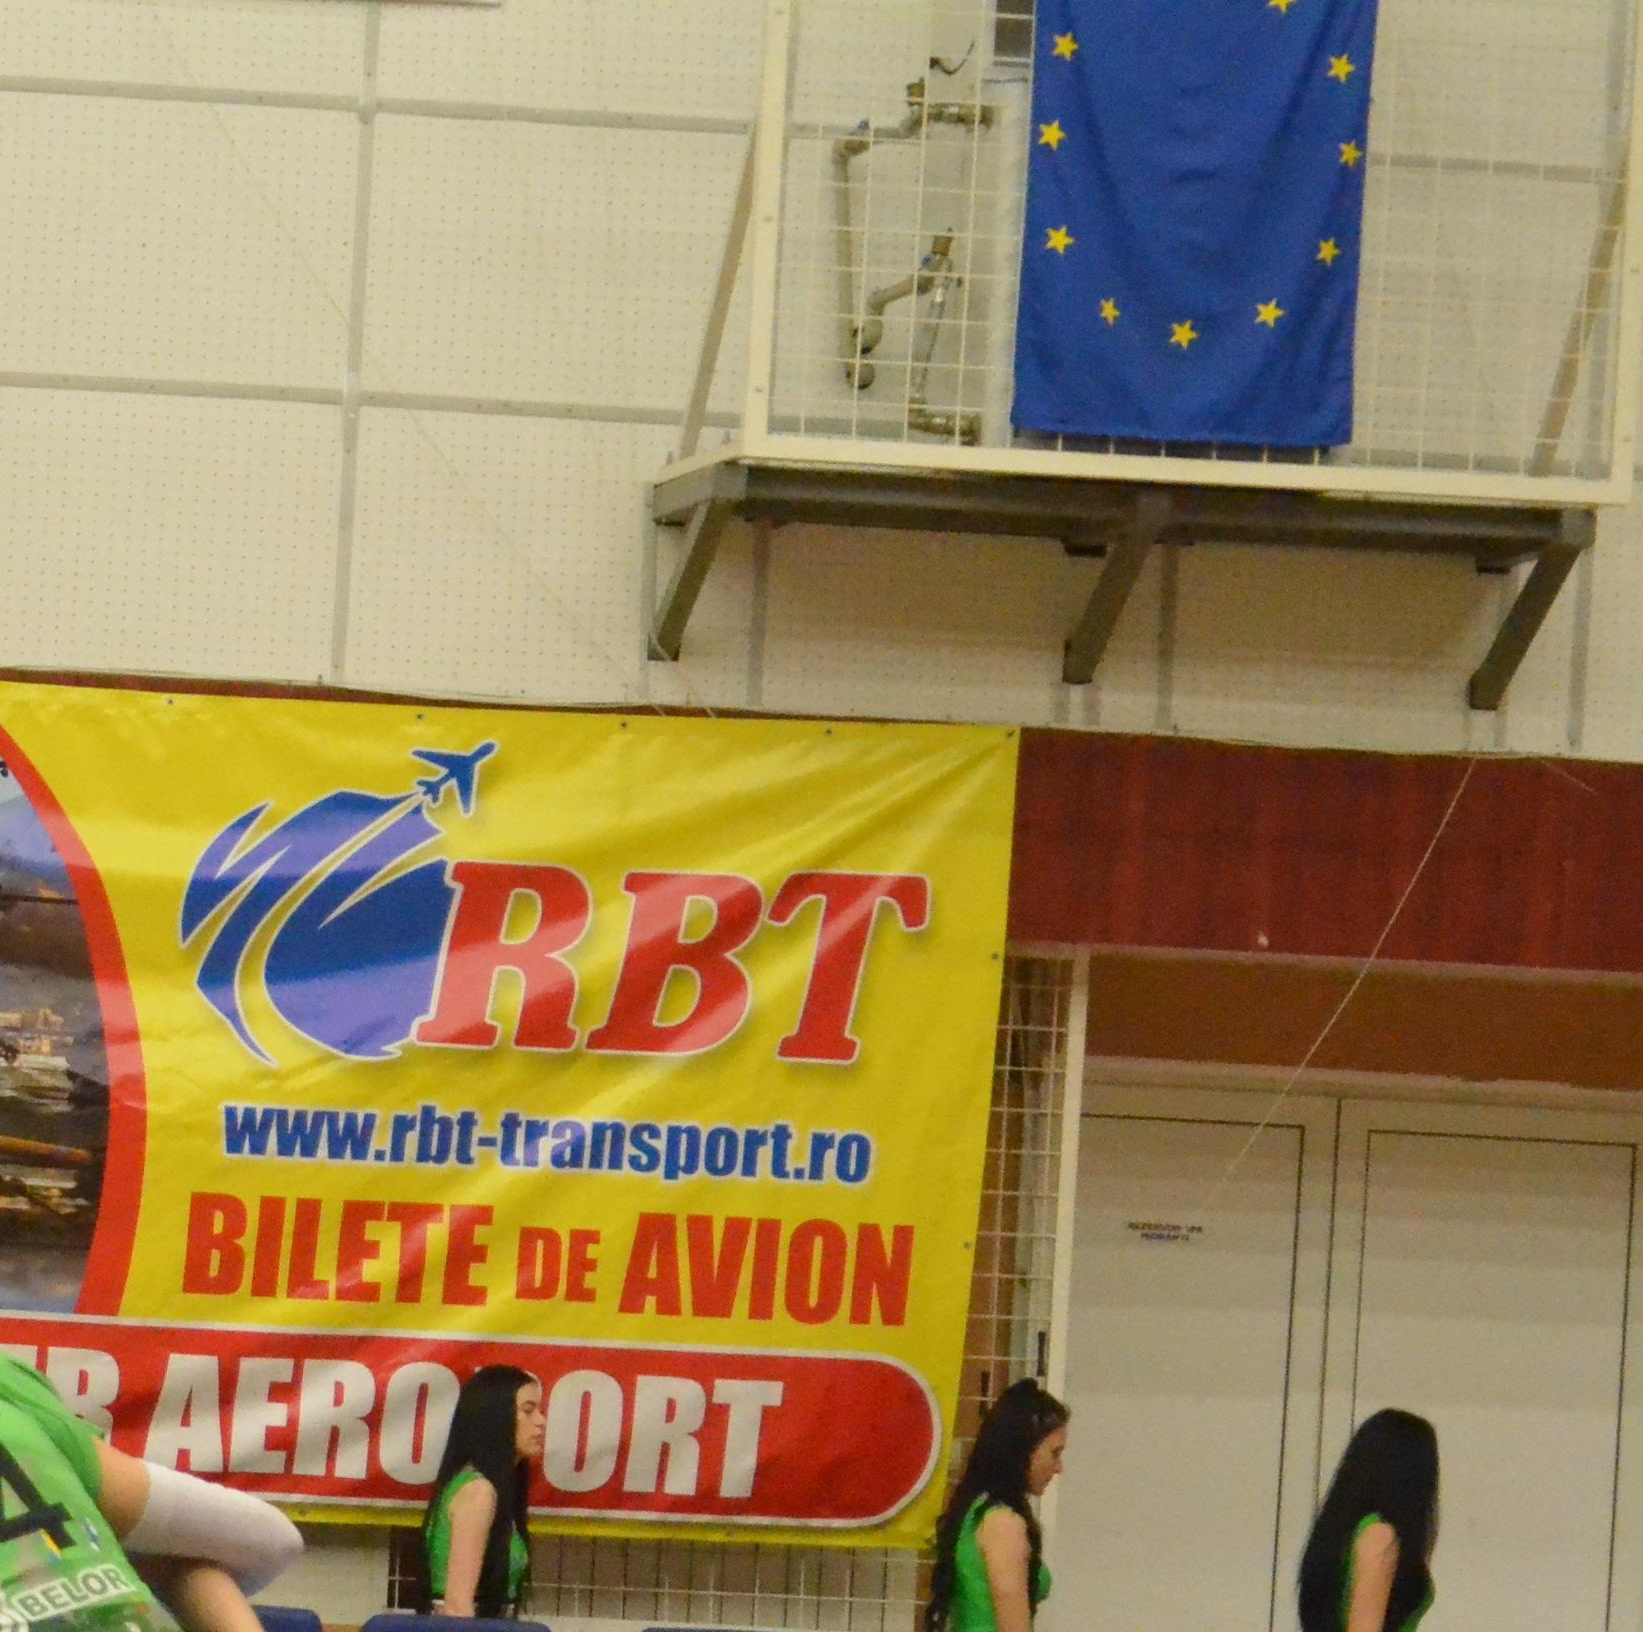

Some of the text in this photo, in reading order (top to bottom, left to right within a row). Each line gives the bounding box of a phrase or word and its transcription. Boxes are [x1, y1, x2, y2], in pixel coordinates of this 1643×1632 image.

[416, 862, 928, 1065] RBT
[224, 1105, 871, 1184] www.rbt-transport.ro
[182, 1192, 914, 1327] BILETE DE AVION
[144, 1353, 784, 1498] AEROORT
[22, 1565, 131, 1620] BELOR
